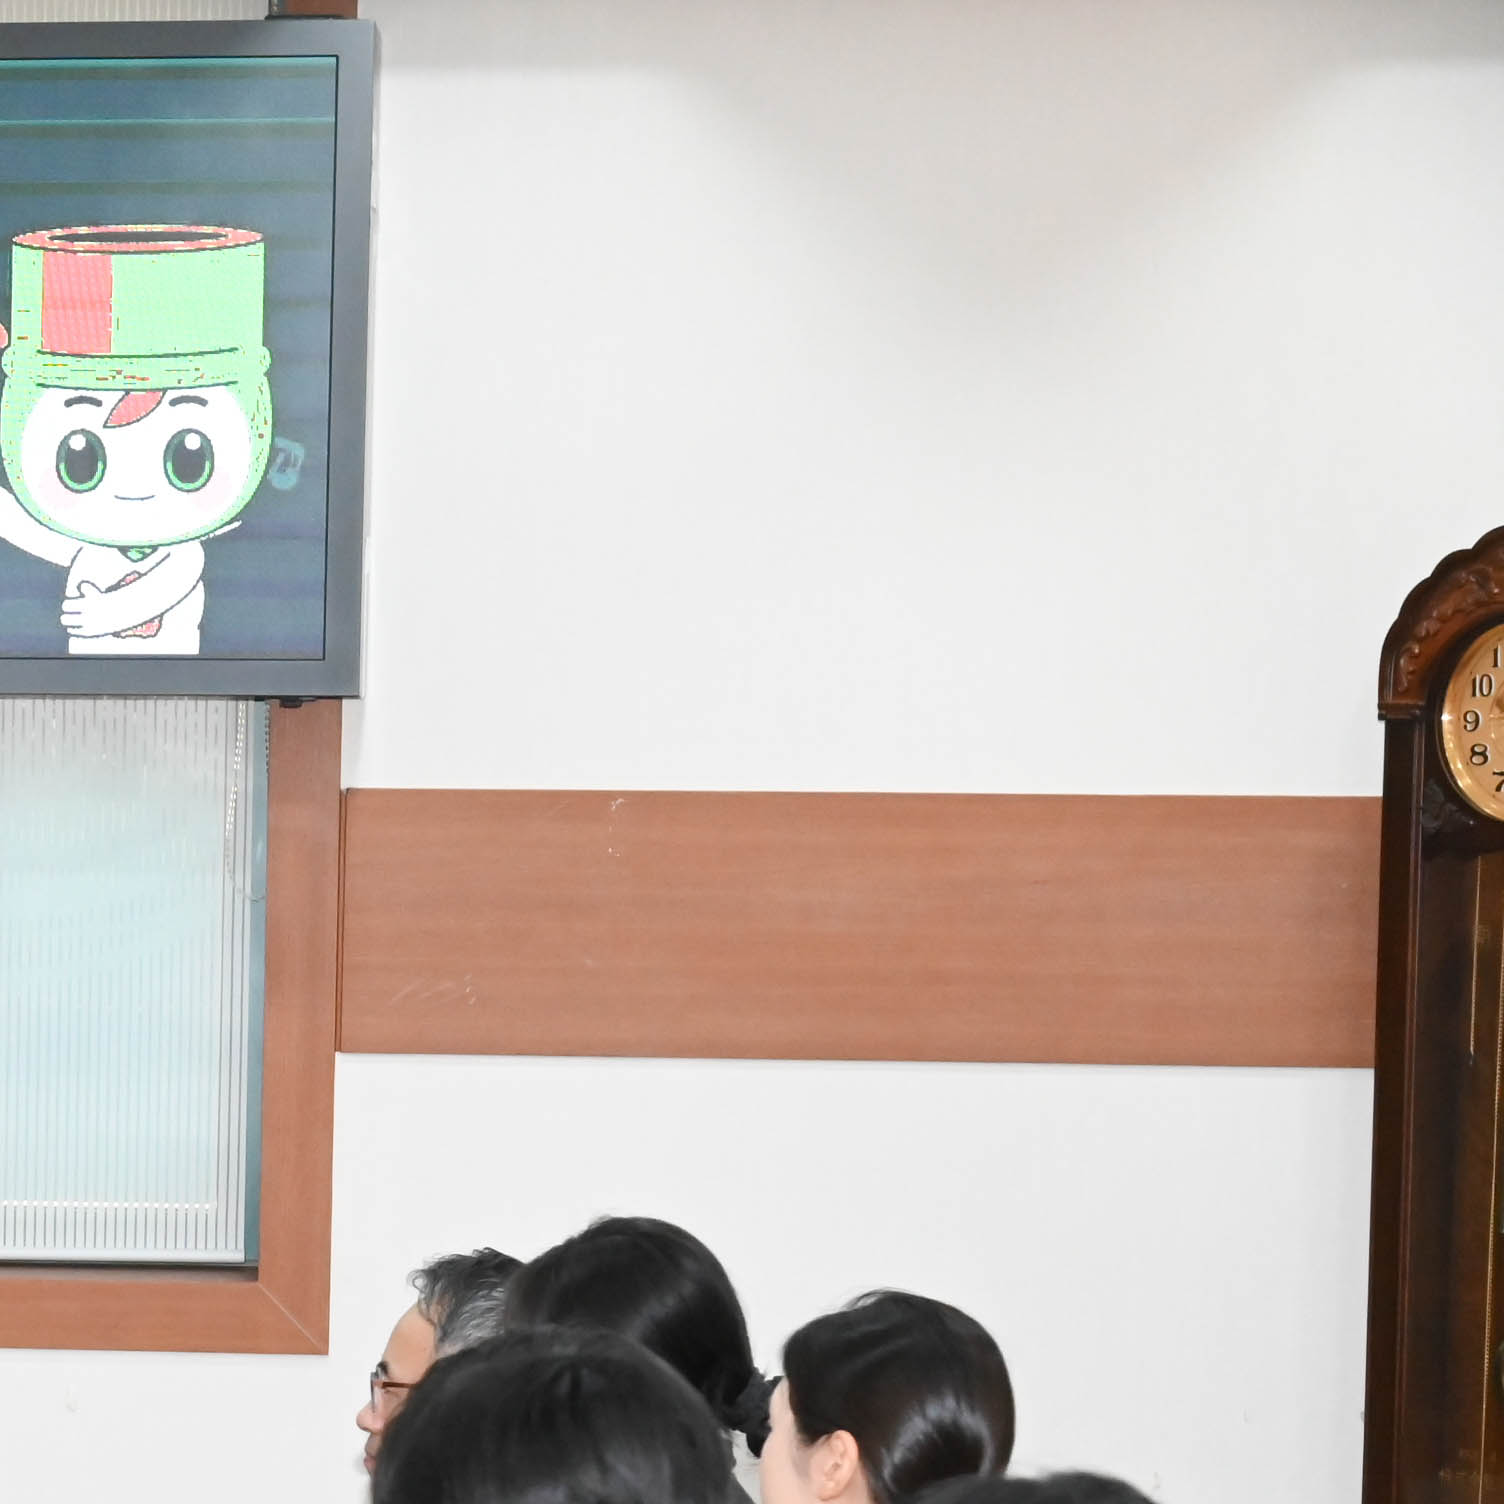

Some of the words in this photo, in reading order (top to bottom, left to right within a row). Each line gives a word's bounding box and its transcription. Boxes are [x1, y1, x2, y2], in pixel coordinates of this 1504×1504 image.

[1472, 673, 1494, 698] 10
[1463, 710, 1481, 732] 9
[1470, 743, 1489, 766] 8
